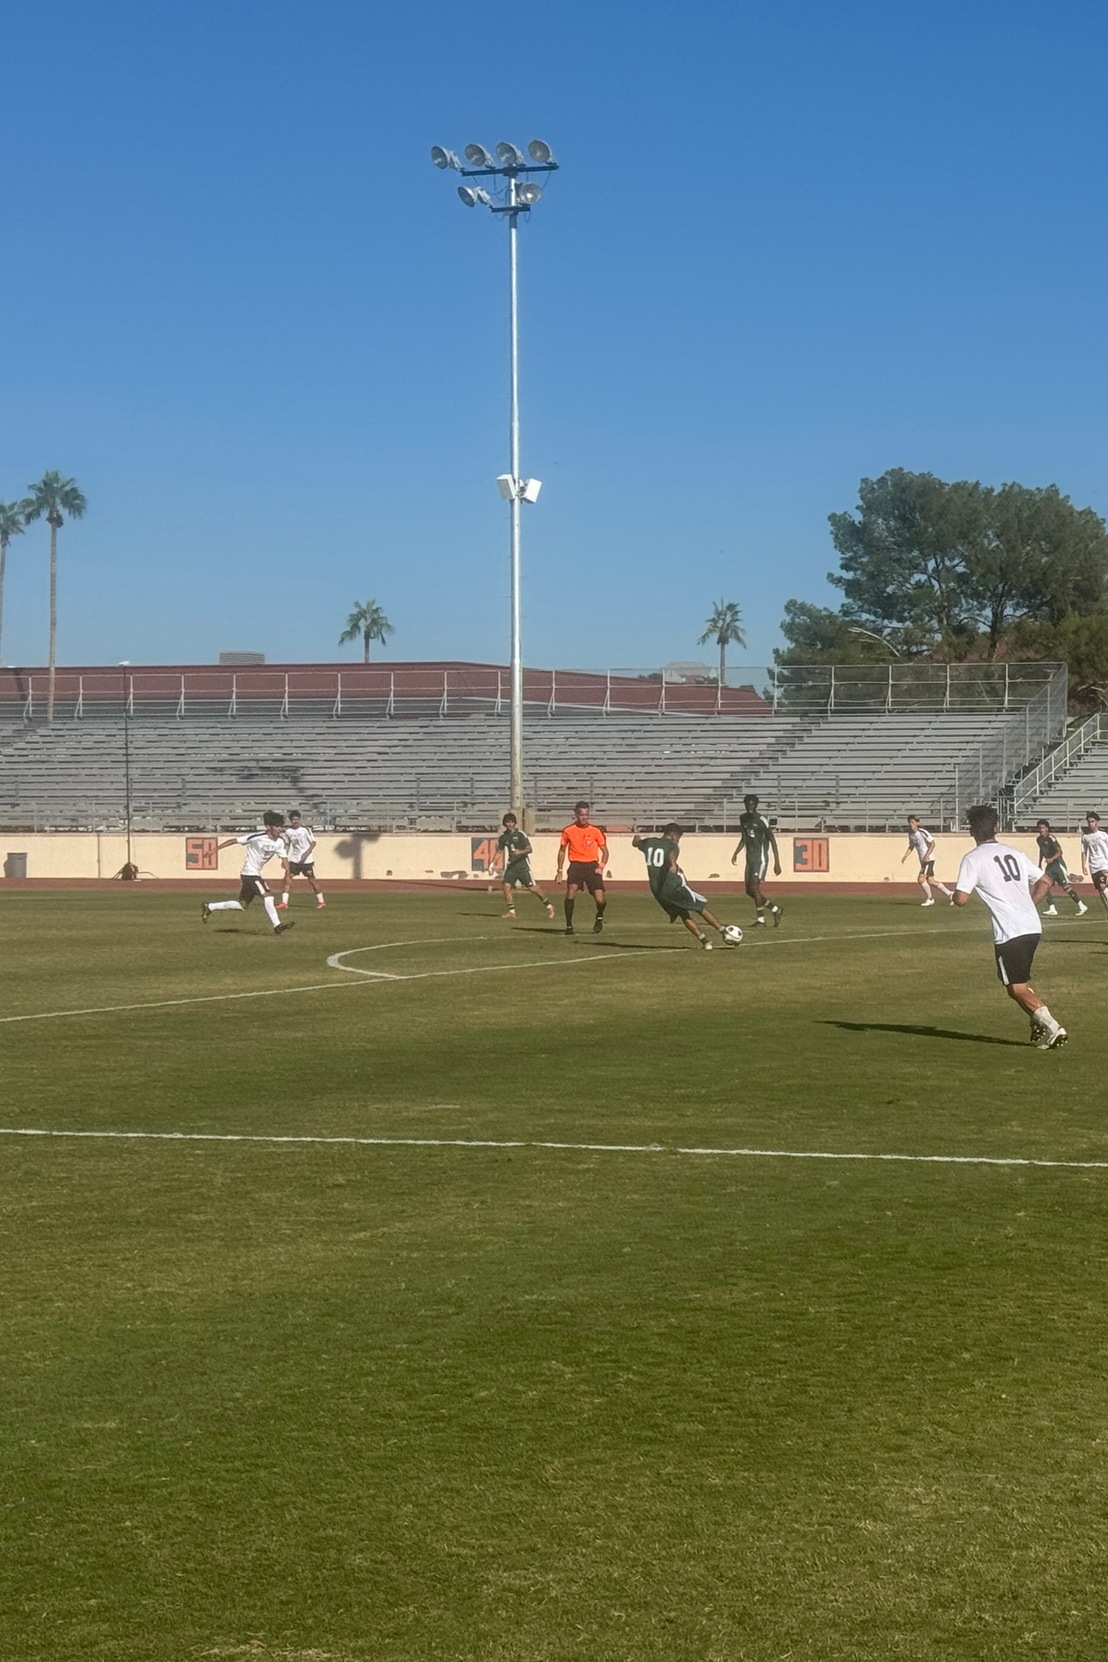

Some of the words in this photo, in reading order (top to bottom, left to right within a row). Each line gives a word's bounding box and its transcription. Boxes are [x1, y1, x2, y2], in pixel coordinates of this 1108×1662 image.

[647, 847, 665, 868] 10
[795, 839, 828, 871] 30
[993, 854, 1021, 882] 10
